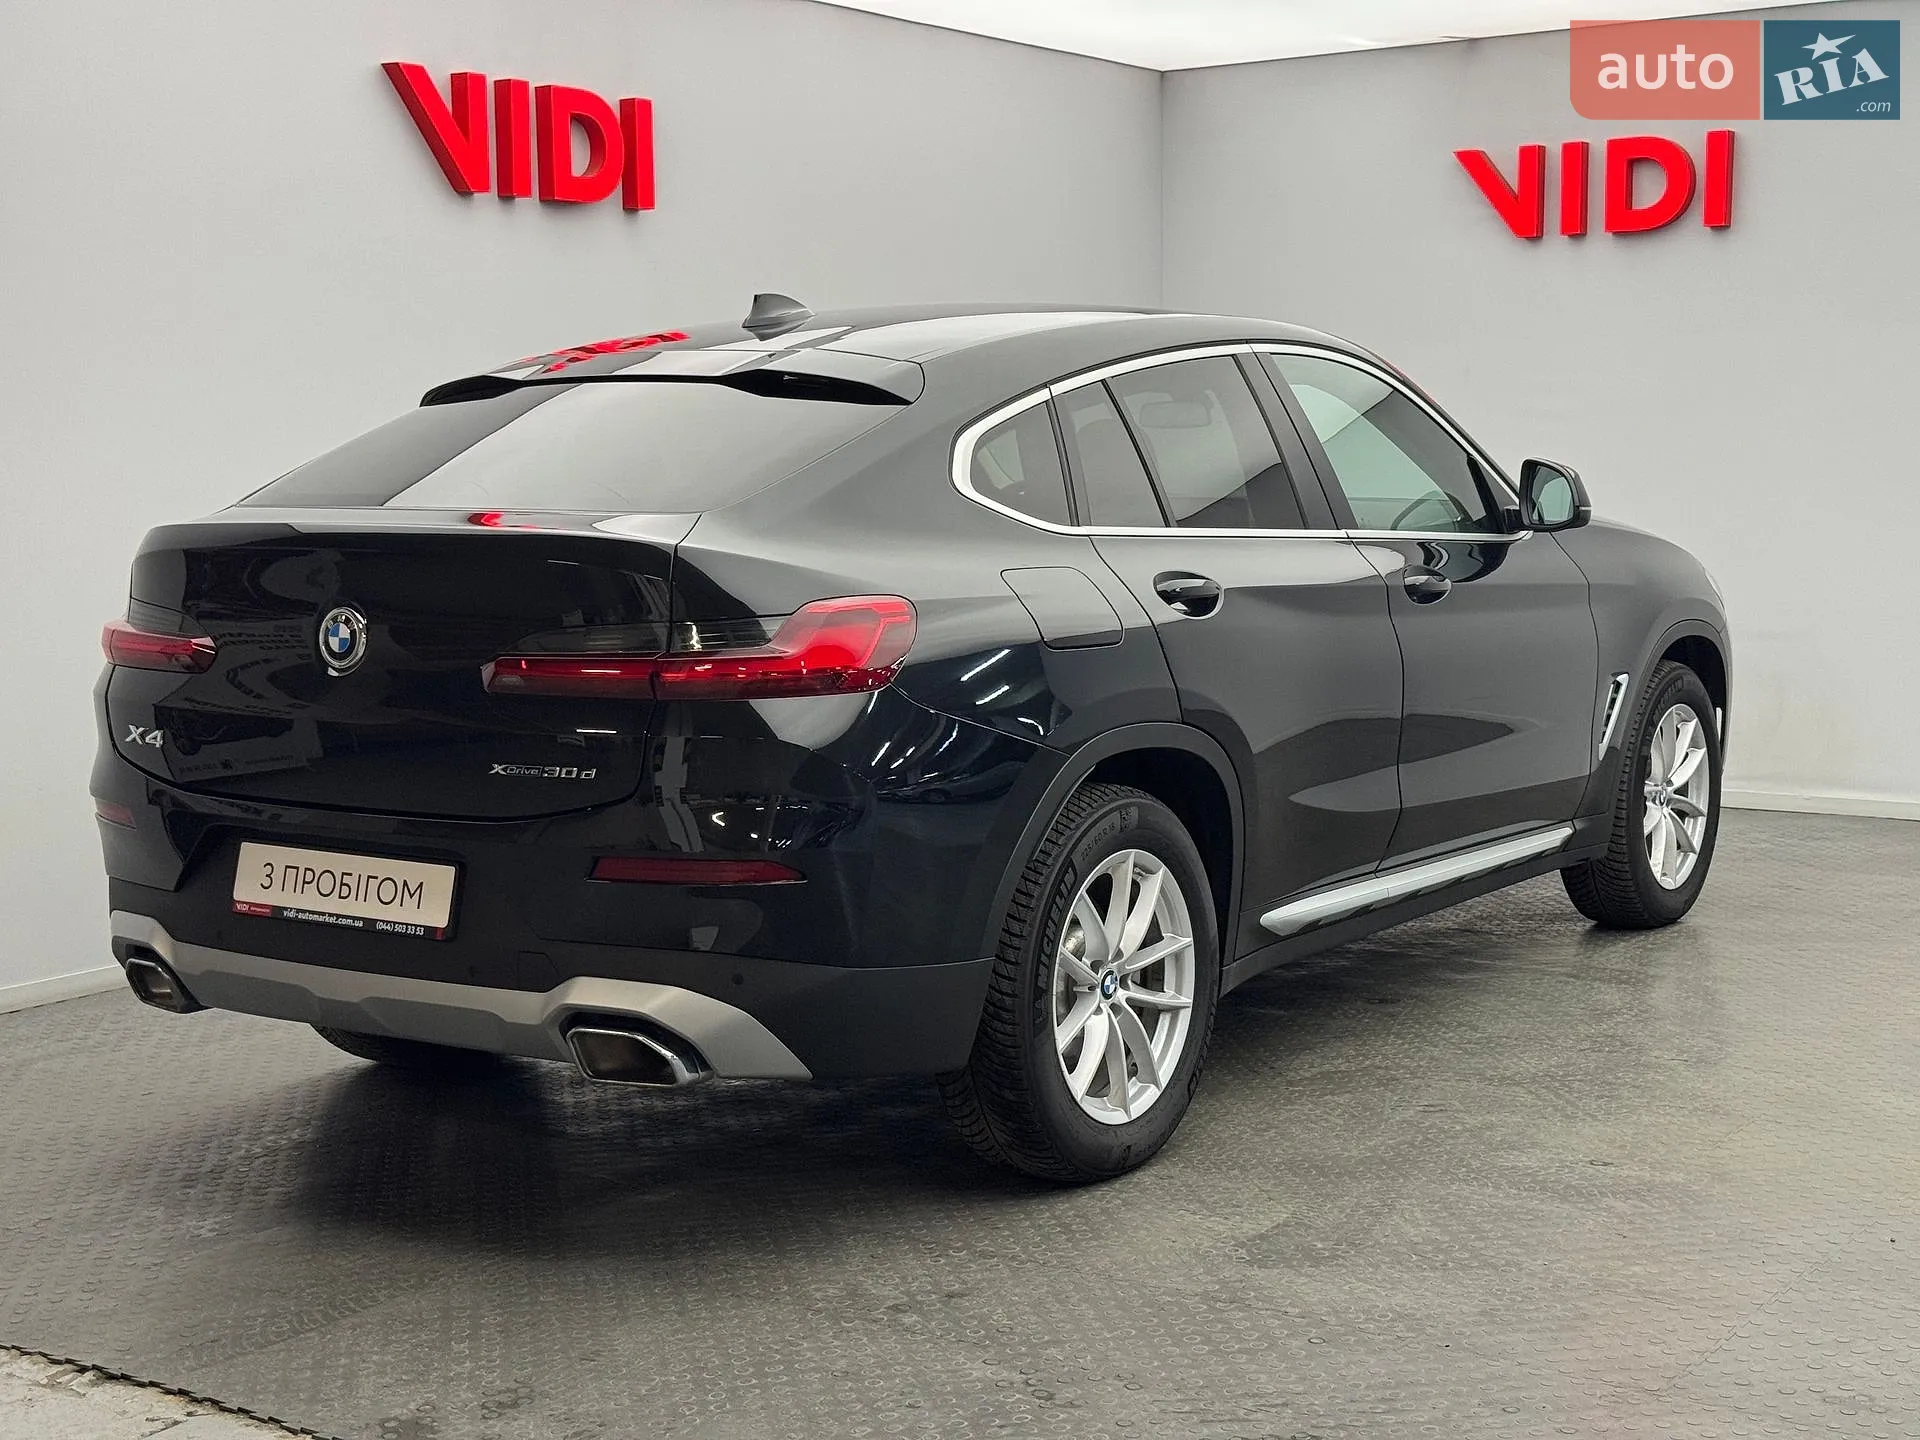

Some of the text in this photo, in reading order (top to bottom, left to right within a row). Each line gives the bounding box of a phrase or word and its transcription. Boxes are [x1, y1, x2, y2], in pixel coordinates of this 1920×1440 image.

[381, 61, 656, 211] VIDI
[1452, 129, 1736, 239] VIDI
[125, 724, 164, 748] X4
[281, 864, 424, 910] ПРОБІГОМ
[283, 908, 364, 928] vidi-automarket.com.ua
[376, 921, 425, 936] (044) 503 33 53
[1037, 866, 1076, 991] MICHELIN
